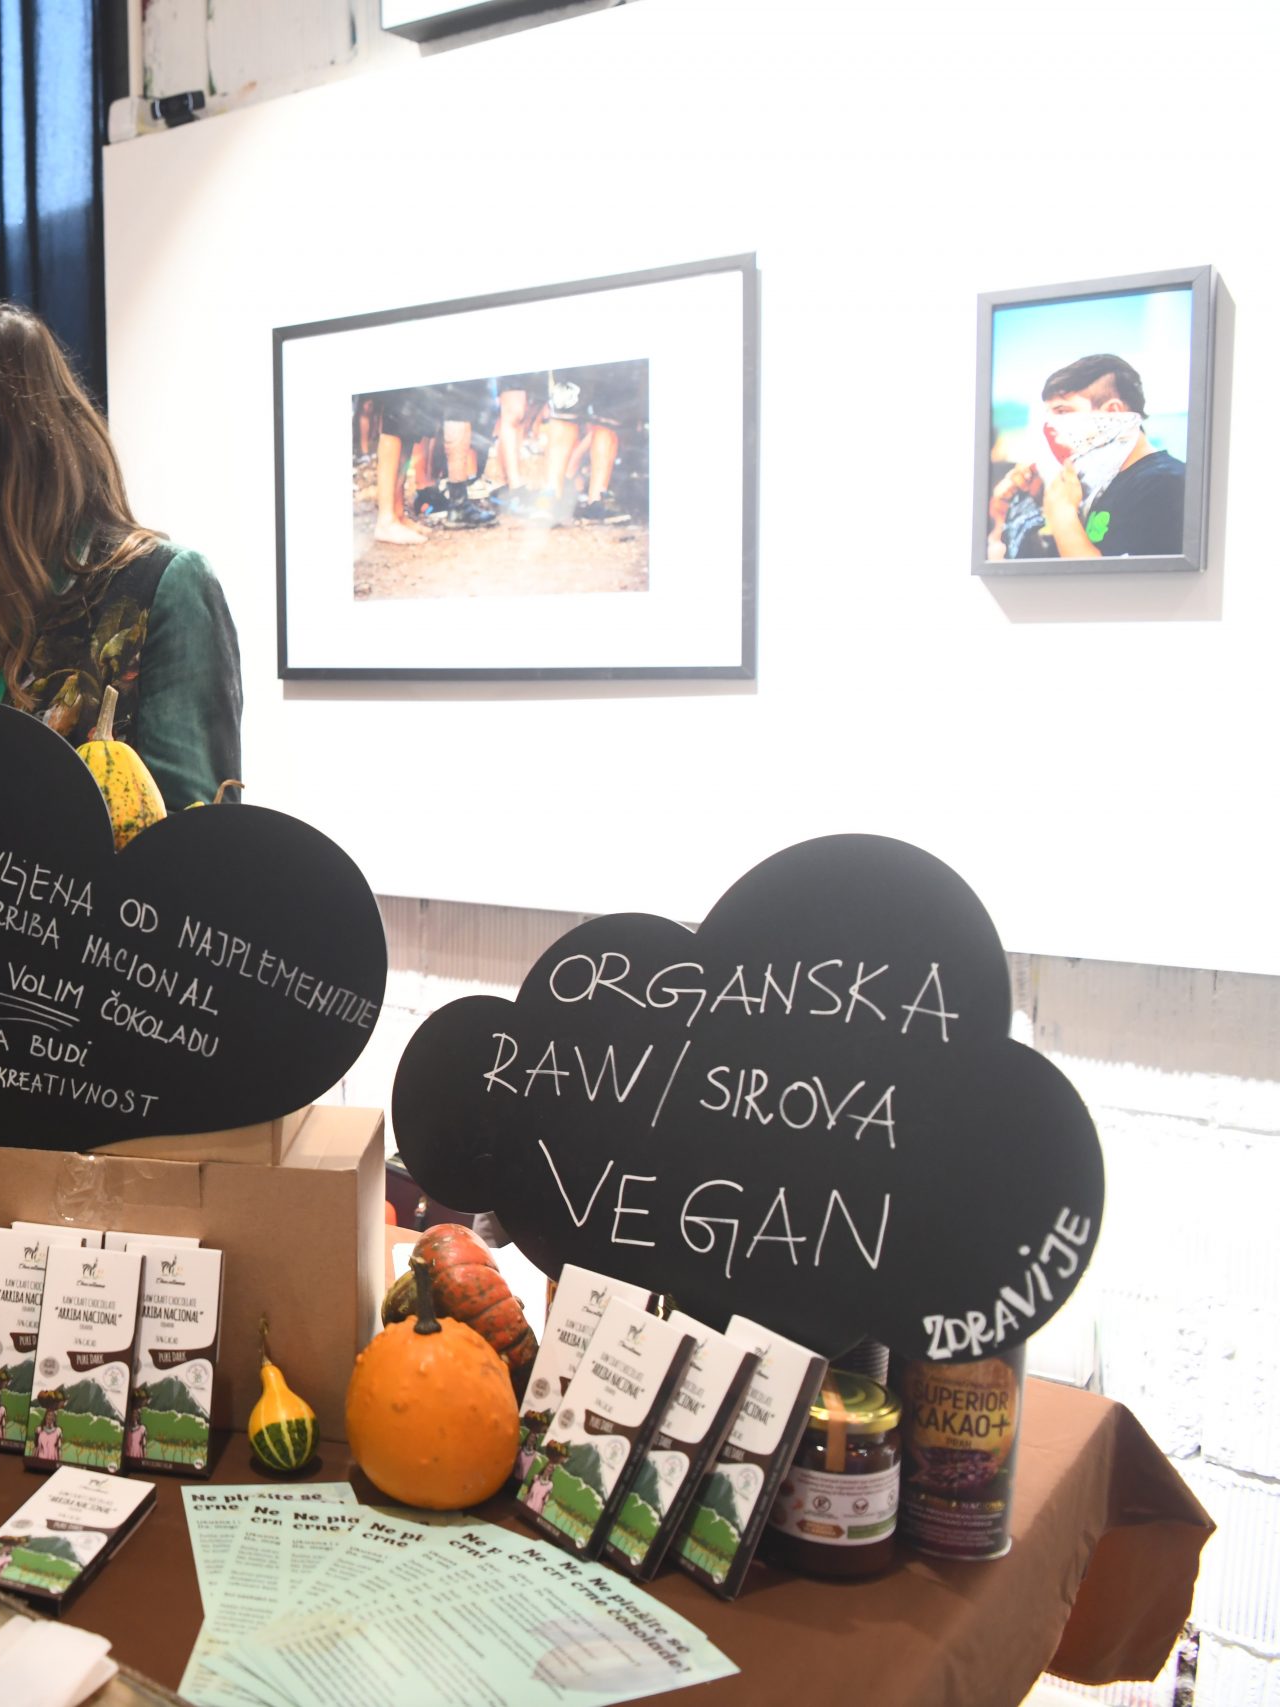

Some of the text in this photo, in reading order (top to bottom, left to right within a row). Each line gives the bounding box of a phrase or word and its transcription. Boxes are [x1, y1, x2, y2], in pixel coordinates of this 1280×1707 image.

[119, 898, 159, 934] OD
[81, 934, 220, 1017] NACIONAL
[549, 952, 960, 1043] ORGANSKA
[7, 961, 86, 1010] VOLIM
[100, 988, 220, 1058] ČOKOLADU
[537, 1139, 891, 1279] VEGAN
[914, 1379, 1009, 1412] SUPERIOR
[192, 1493, 207, 1502] Ne
[193, 1503, 239, 1511] crne
[254, 1505, 280, 1516] Ne
[293, 1512, 320, 1522] Ne
[292, 1523, 341, 1532] crne
[370, 1522, 396, 1534] Ne
[361, 1531, 409, 1548] crne
[461, 1532, 488, 1548] Ne
[523, 1548, 547, 1563] Ne
[559, 1561, 583, 1576] Ne
[588, 1577, 691, 1655] Ne plašite se
[571, 1581, 693, 1675] crne čokolade!
